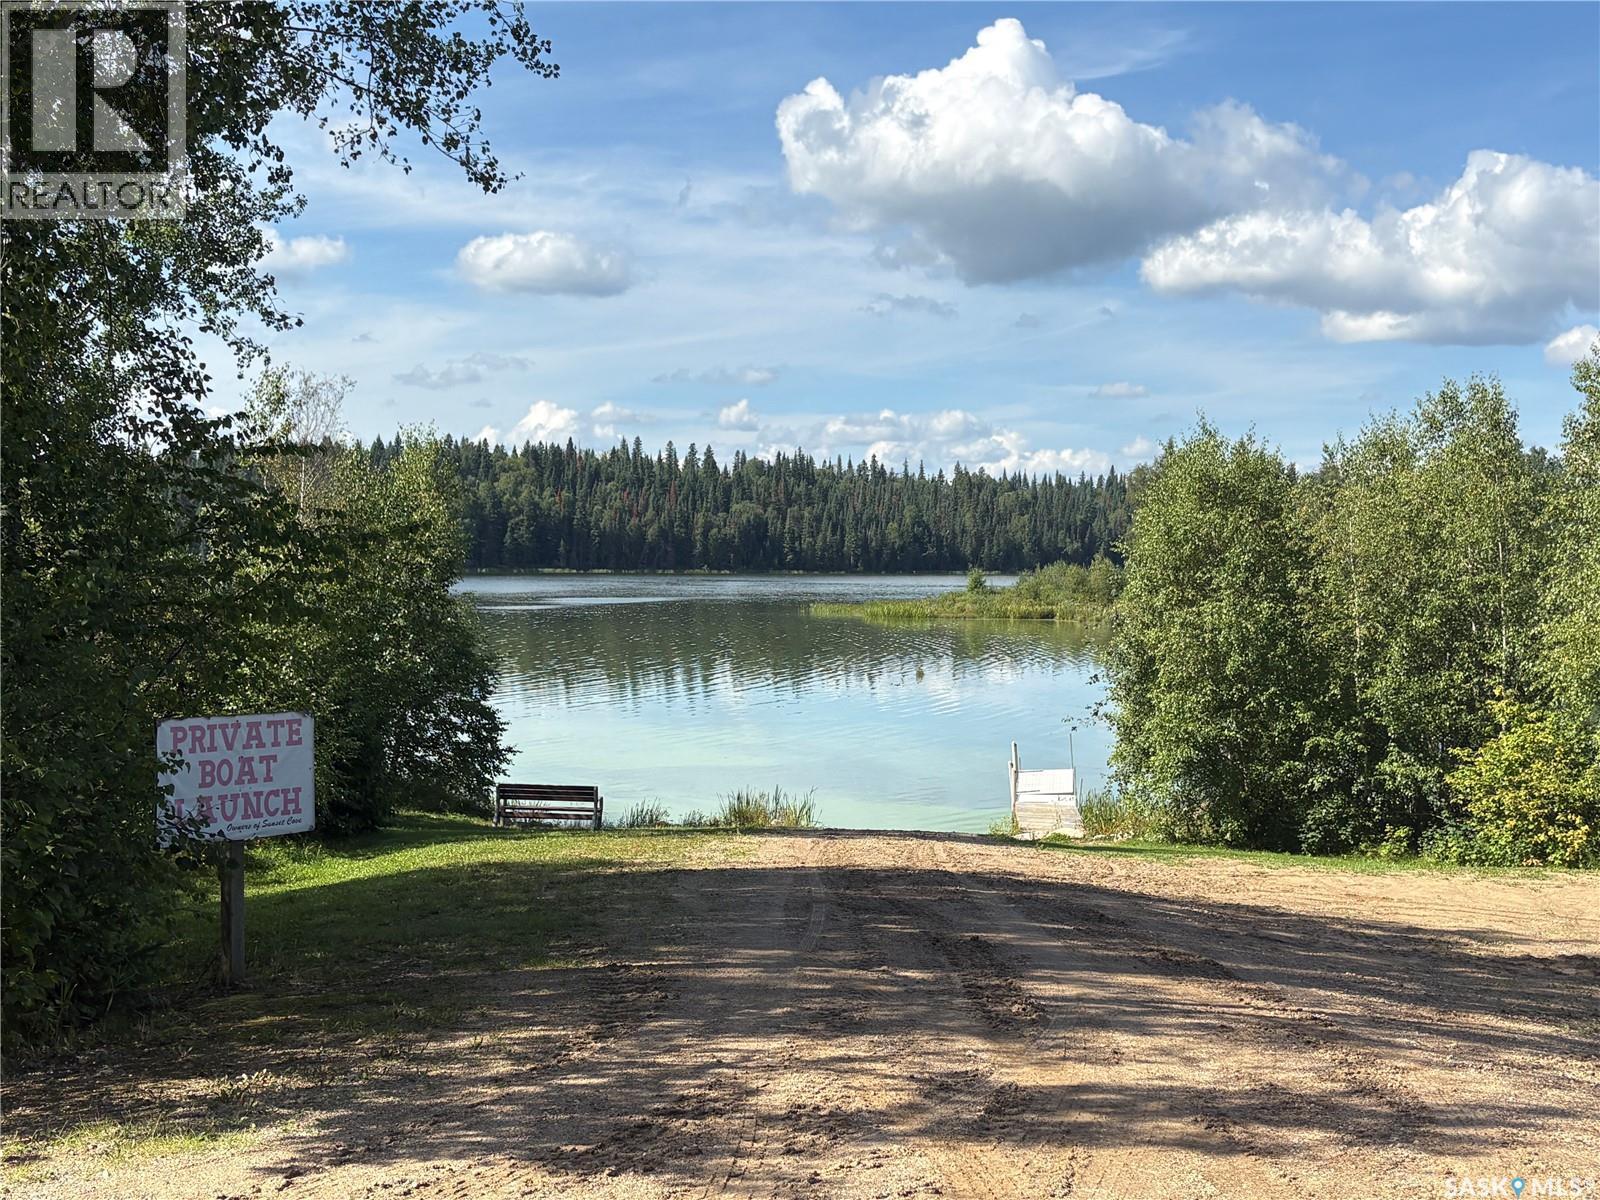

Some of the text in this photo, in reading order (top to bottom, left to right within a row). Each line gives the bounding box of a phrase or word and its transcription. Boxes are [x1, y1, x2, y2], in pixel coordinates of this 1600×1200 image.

[170, 718, 302, 754] PRIVATE
[198, 755, 277, 788] BOAT
[226, 816, 302, 832] Owners of Sunset Cove
